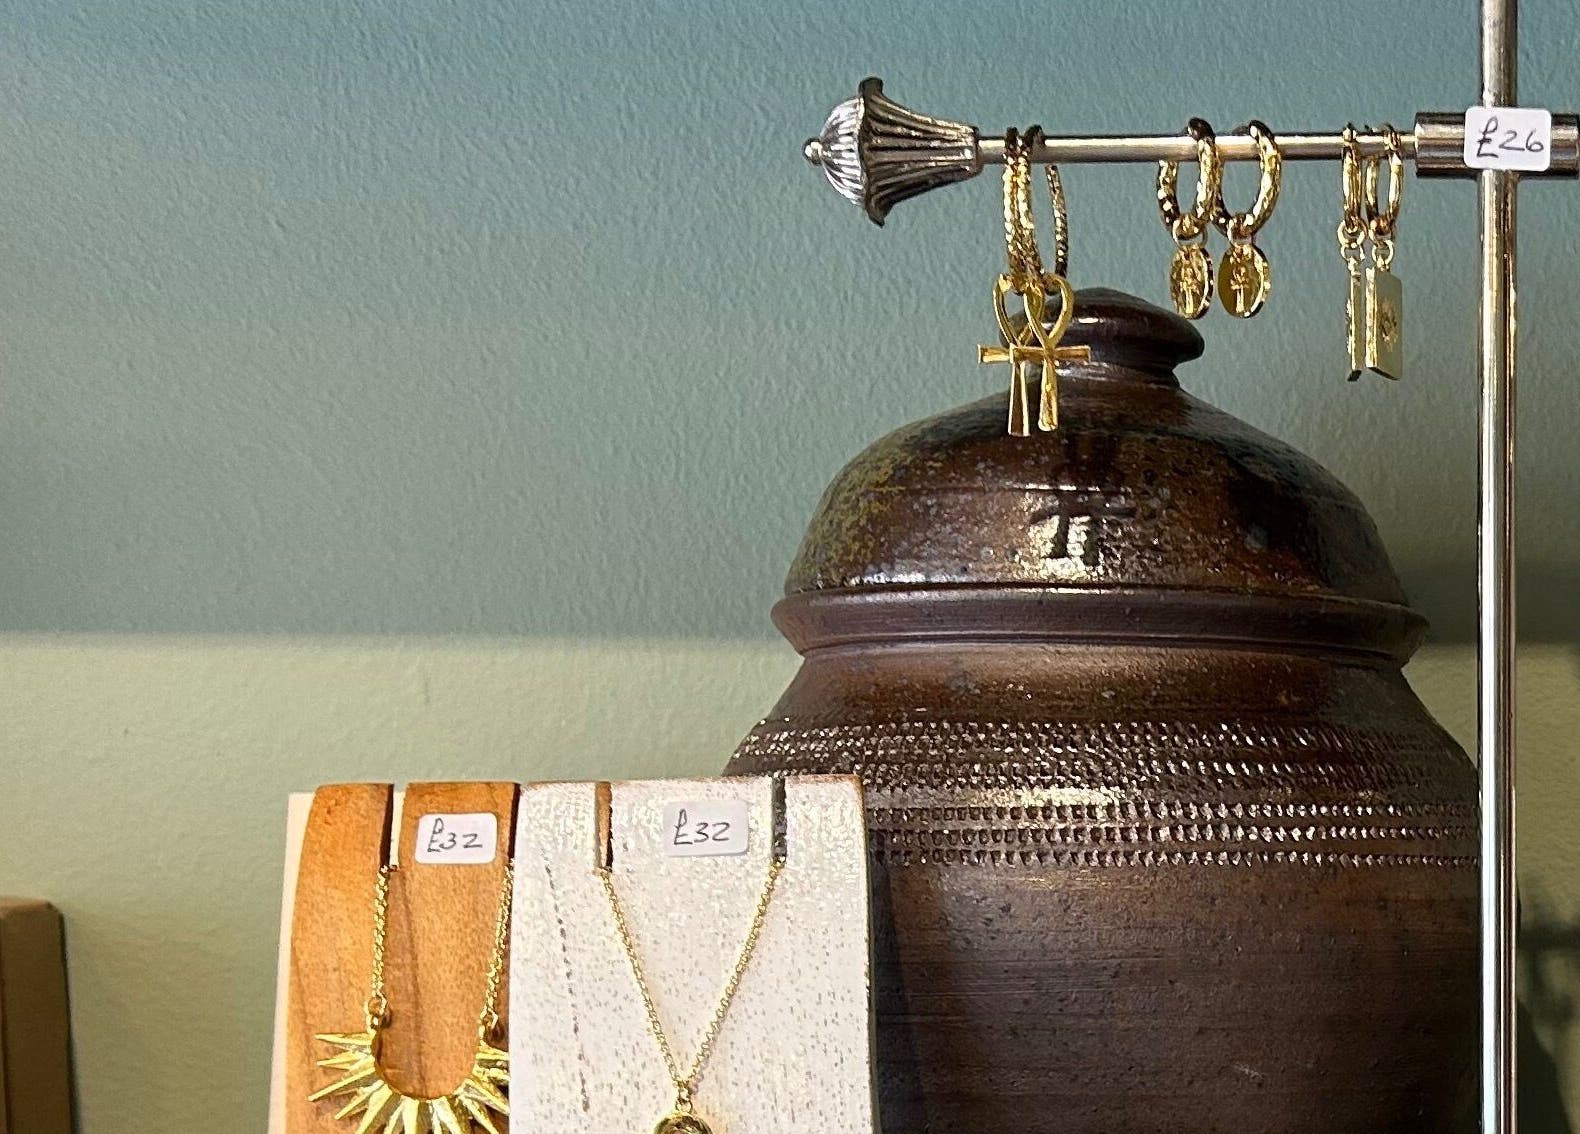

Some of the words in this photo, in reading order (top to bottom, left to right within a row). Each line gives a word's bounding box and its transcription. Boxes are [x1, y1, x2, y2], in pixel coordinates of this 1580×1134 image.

[1476, 115, 1545, 159] £26
[427, 817, 484, 853] £32
[673, 807, 731, 846] £32
